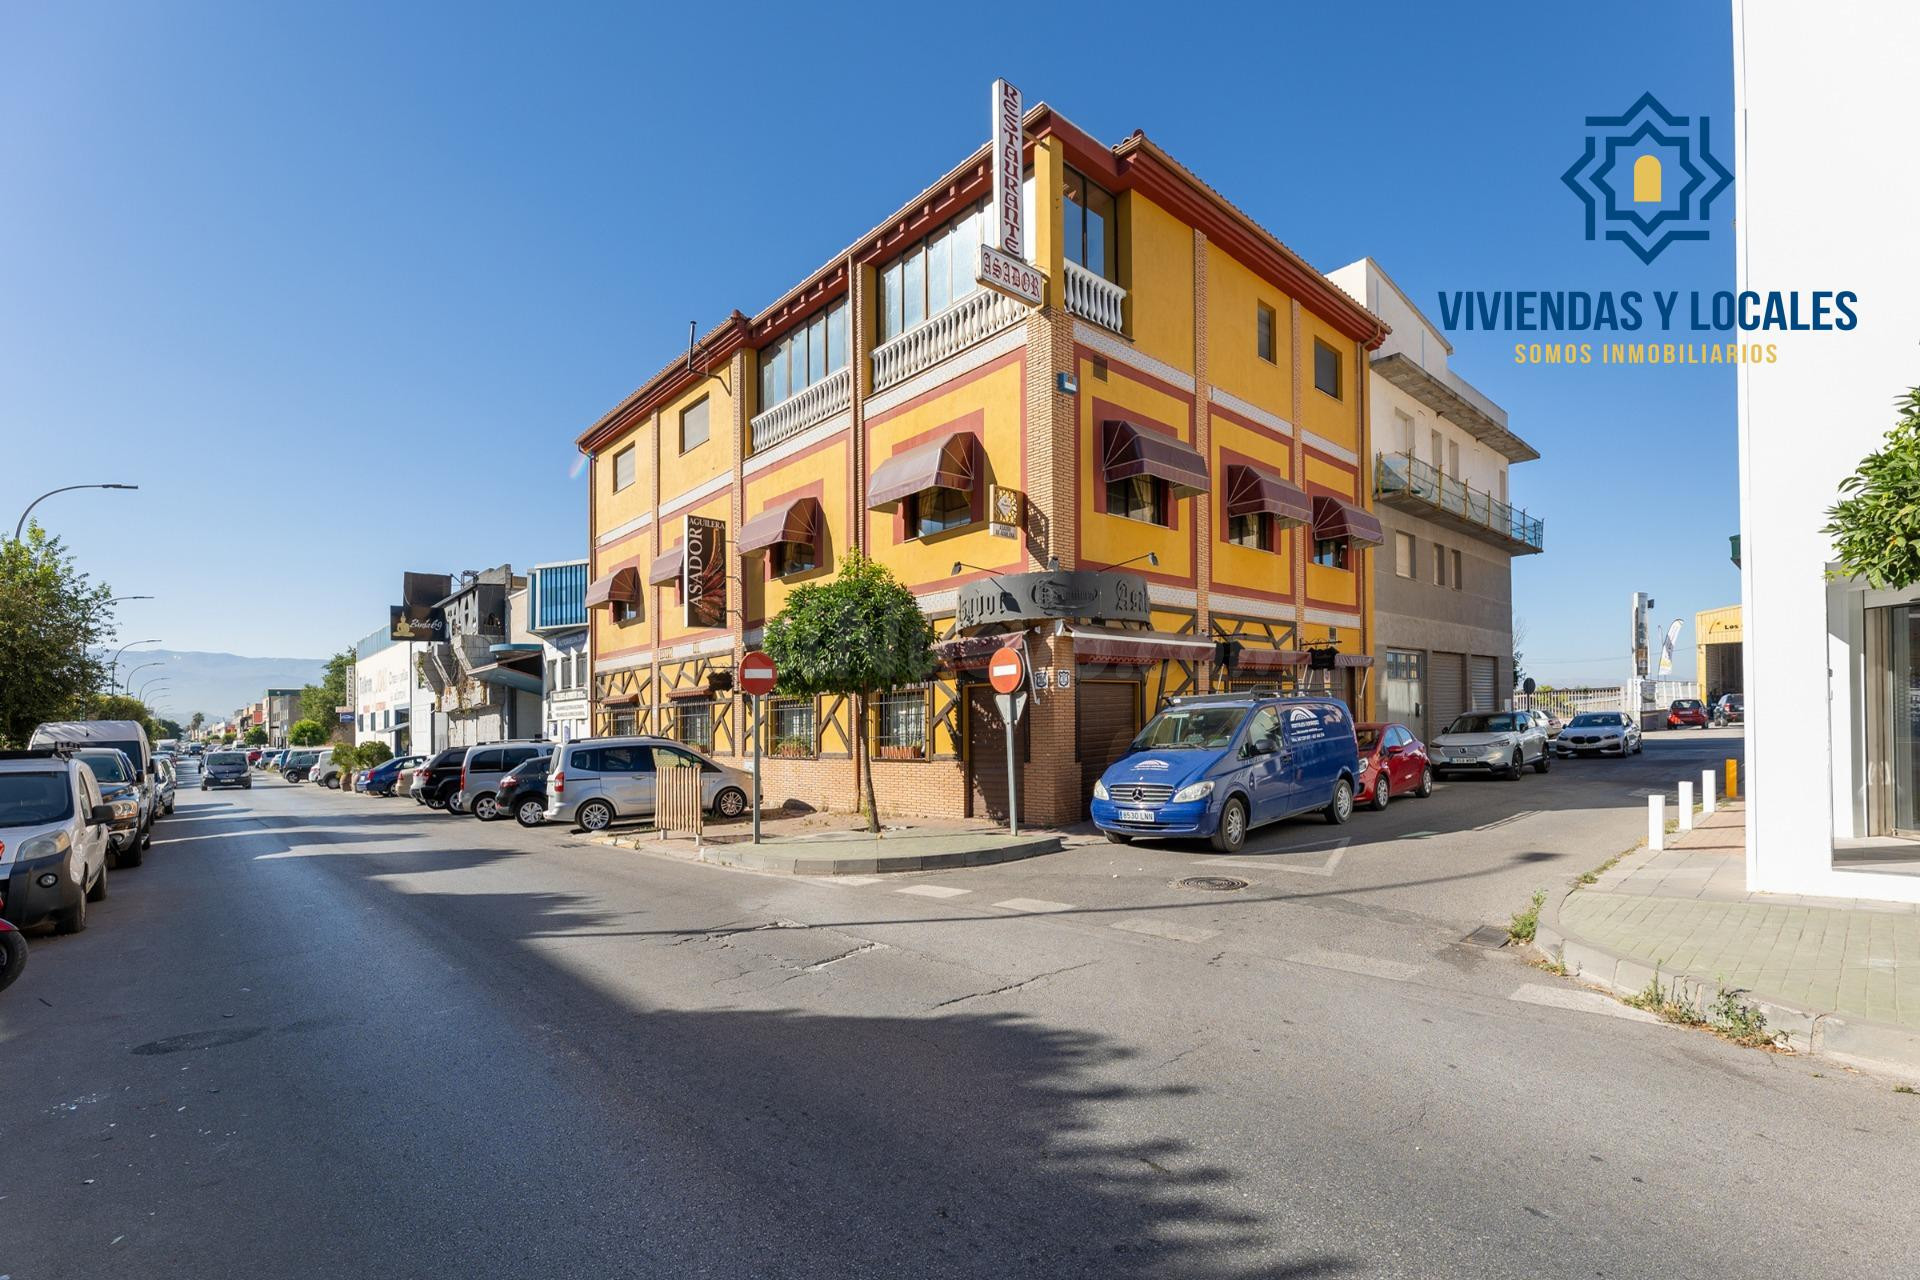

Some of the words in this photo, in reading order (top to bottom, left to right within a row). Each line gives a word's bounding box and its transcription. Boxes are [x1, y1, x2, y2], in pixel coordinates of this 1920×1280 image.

[1003, 83, 1020, 255] RESTAURANTE
[983, 252, 1040, 298] ASADOR
[689, 517, 726, 529] AGUILERA
[688, 527, 703, 609] ASADOR
[1140, 812, 1153, 820] LNN
